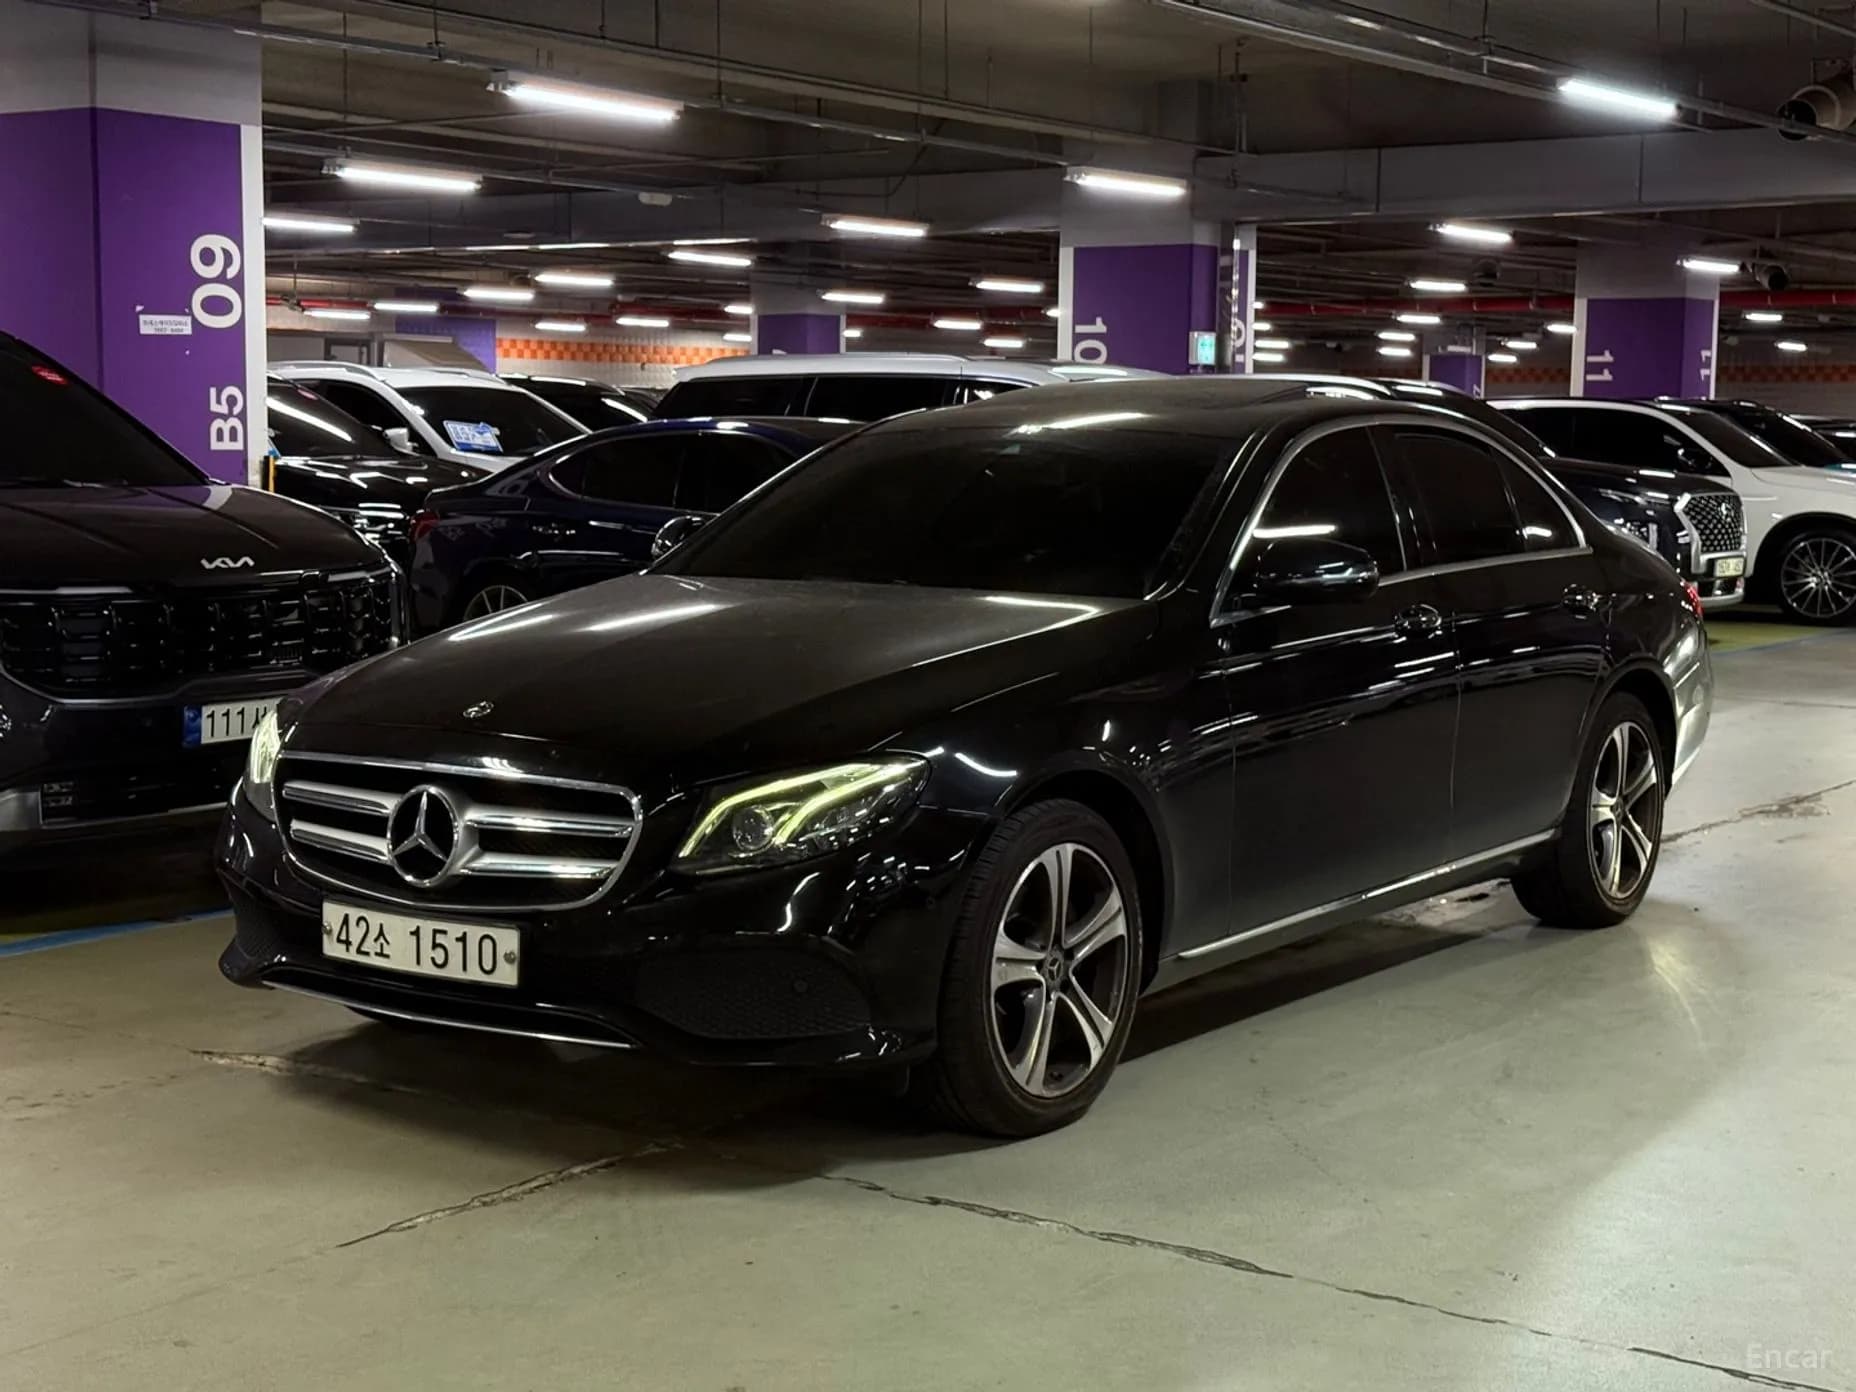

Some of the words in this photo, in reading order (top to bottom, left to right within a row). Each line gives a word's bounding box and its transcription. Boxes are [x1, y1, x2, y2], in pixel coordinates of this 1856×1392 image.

[190, 234, 242, 328] 09
[1074, 317, 1108, 364] 10
[1586, 350, 1614, 381] 11
[210, 386, 244, 450] B5
[336, 913, 391, 959] 42소
[409, 925, 498, 975] 1510
